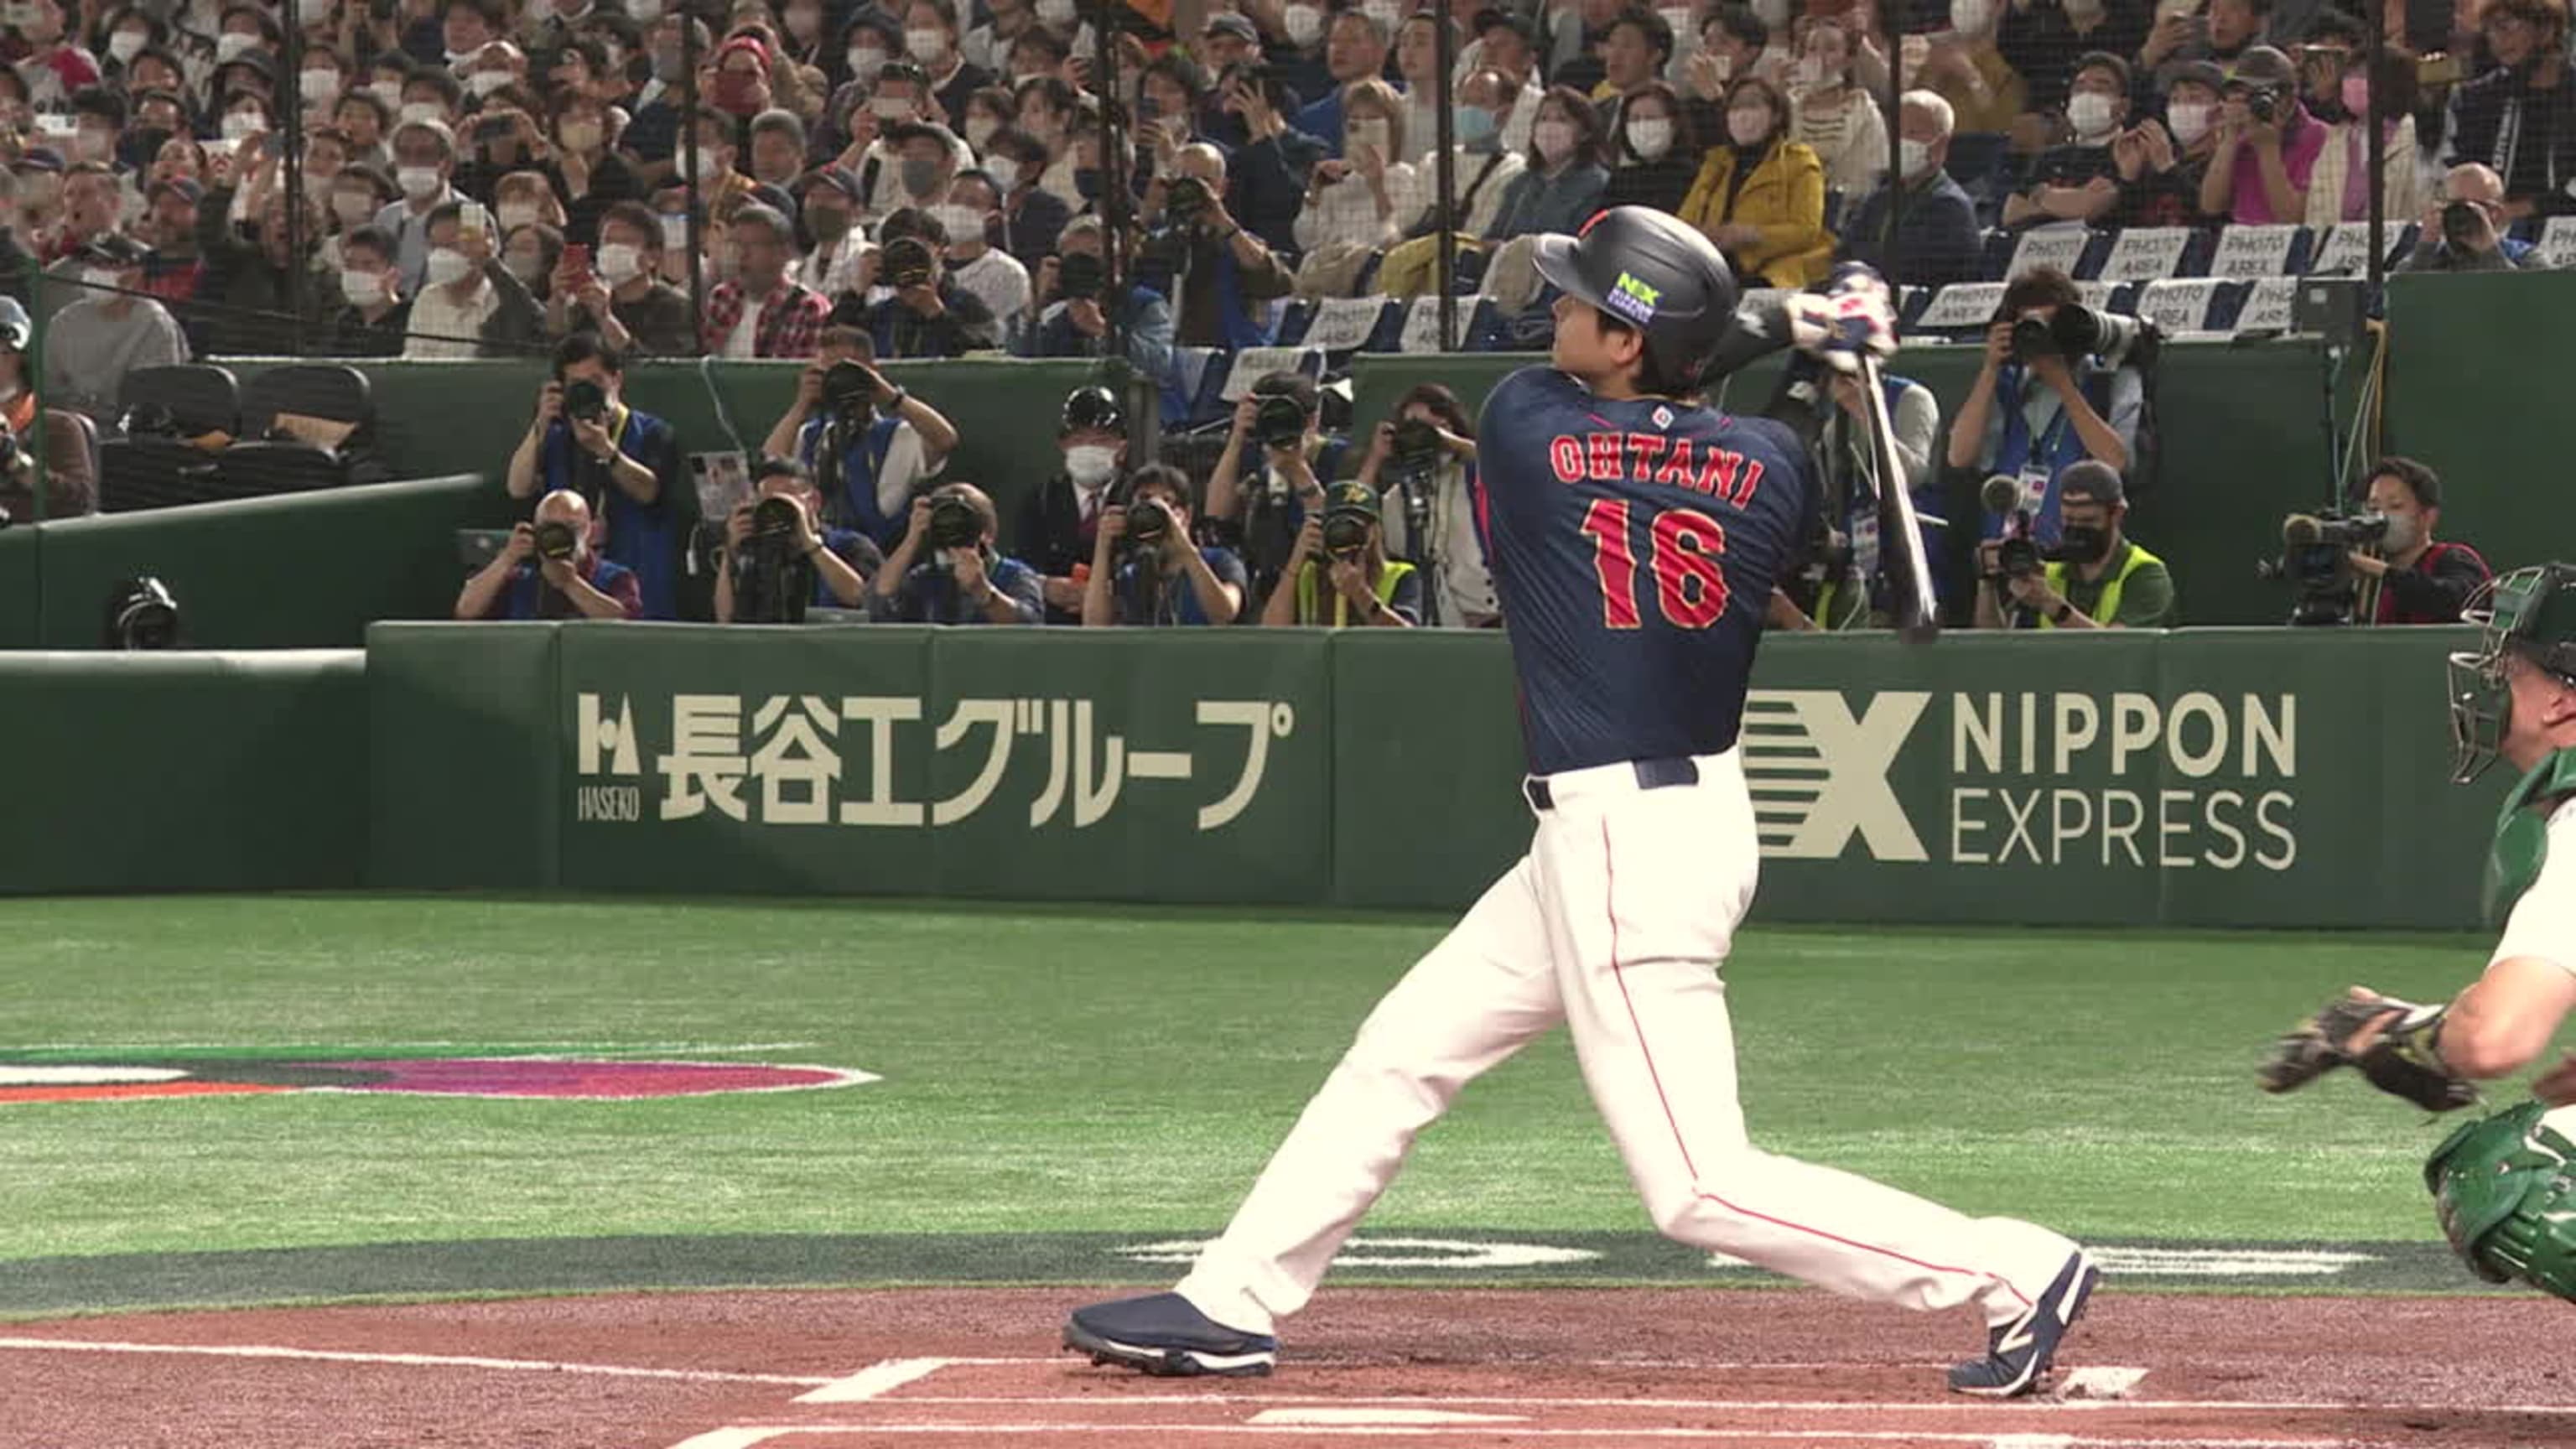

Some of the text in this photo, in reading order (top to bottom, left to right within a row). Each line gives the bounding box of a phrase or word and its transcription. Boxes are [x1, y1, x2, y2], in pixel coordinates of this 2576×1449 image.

[1550, 432, 1765, 511] OHTANI
[1580, 499, 1731, 629] 16
[657, 693, 1294, 830] 長谷工グループ
[1953, 691, 2296, 778] NIPPON
[578, 787, 640, 822] HASEKO
[1952, 787, 2297, 870] EXPRESS
